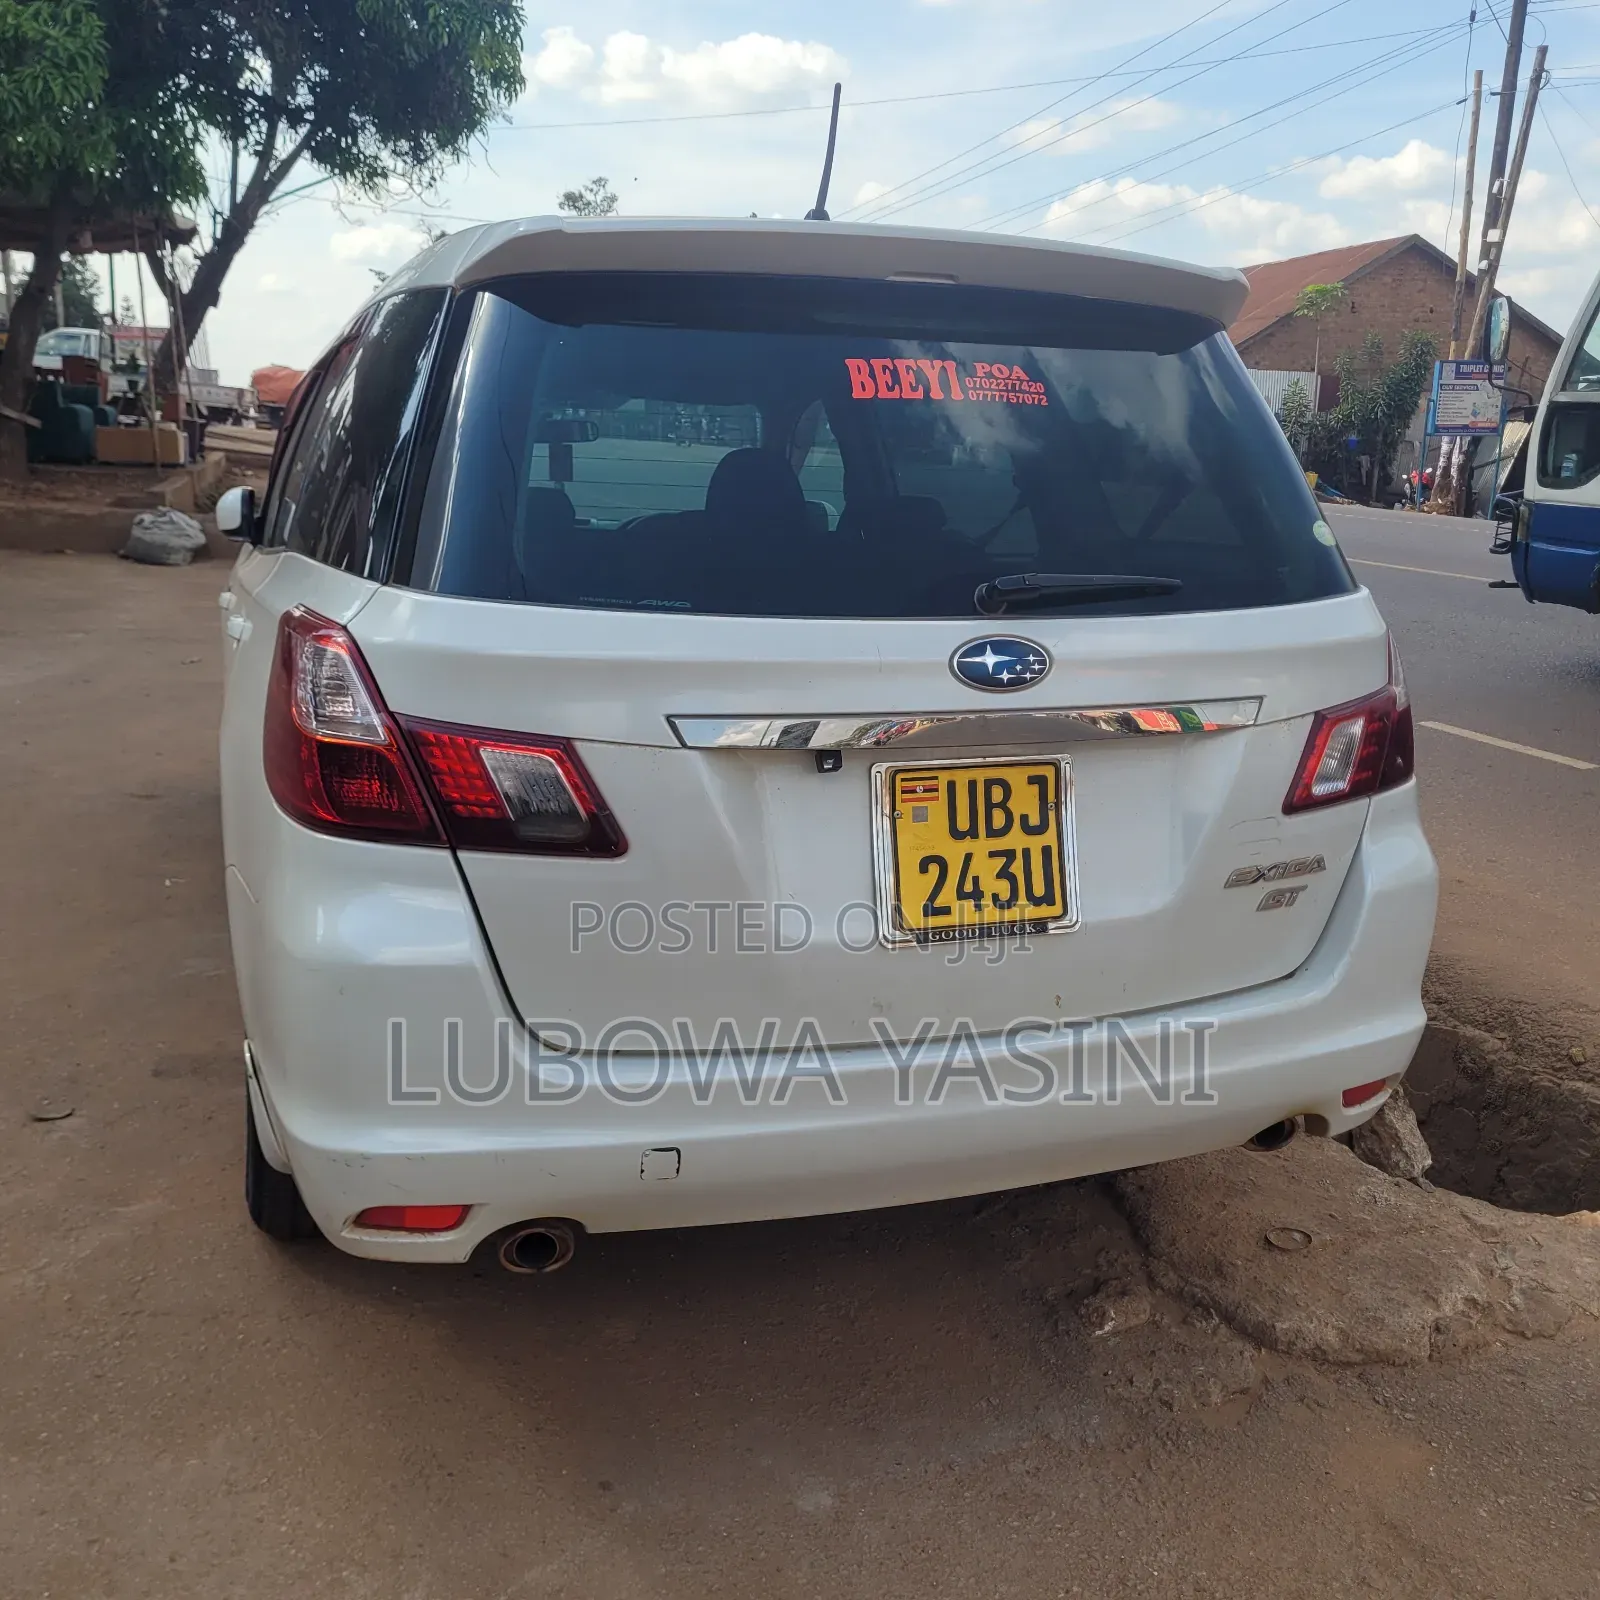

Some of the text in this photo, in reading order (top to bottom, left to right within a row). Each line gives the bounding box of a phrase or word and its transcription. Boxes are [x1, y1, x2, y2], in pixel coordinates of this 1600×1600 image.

[1460, 364, 1505, 373] TRIPLET CNIC
[845, 358, 1030, 401] BEEYI POA
[965, 377, 1045, 393] 0702277420
[968, 390, 1048, 406] 0777757072
[637, 599, 692, 608] AWD
[946, 774, 1049, 841] UBJ
[918, 845, 1056, 917] 243U
[1256, 884, 1308, 912] GT
[928, 923, 1037, 941] GOOD LUCK
